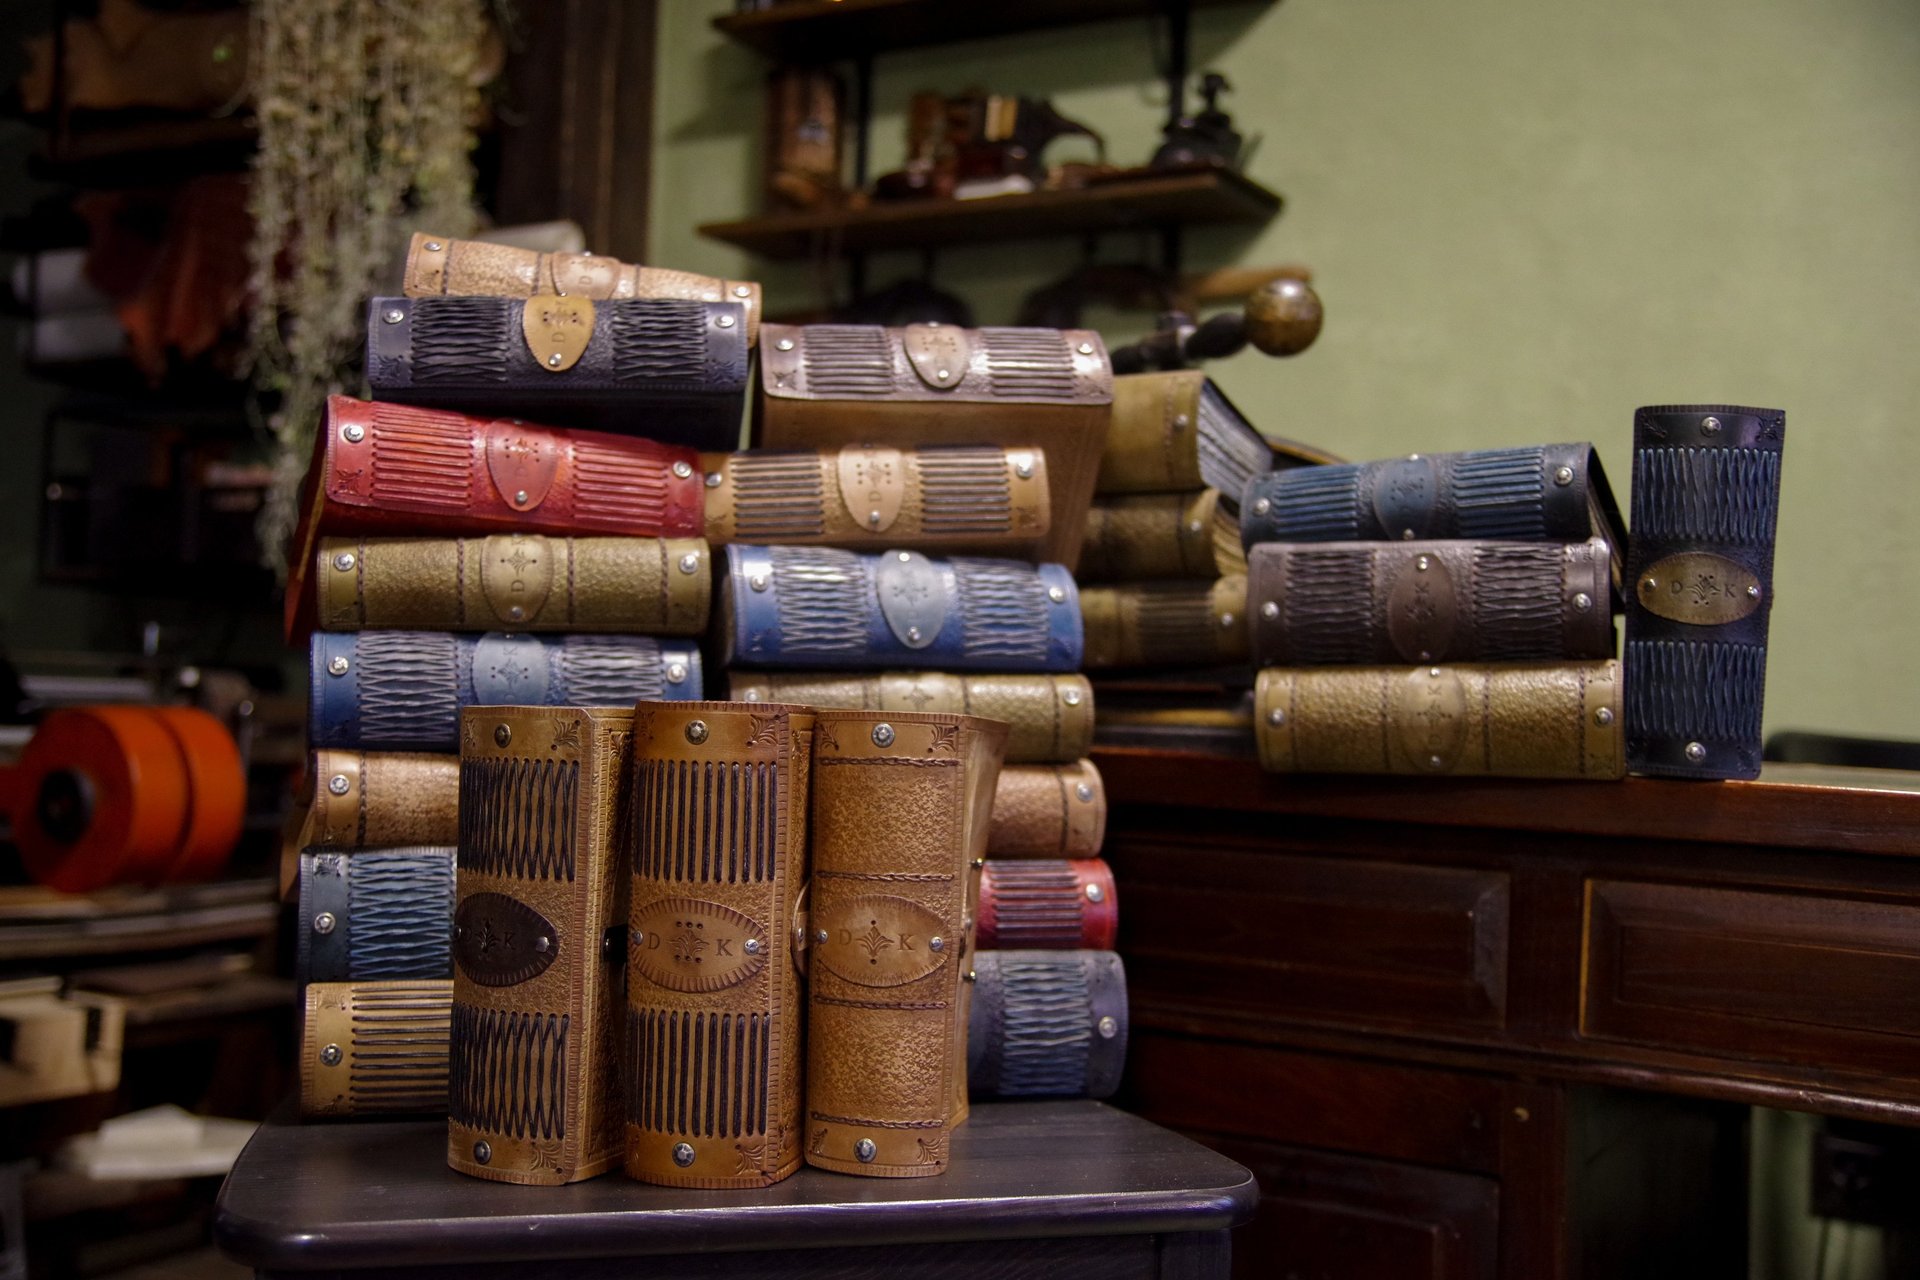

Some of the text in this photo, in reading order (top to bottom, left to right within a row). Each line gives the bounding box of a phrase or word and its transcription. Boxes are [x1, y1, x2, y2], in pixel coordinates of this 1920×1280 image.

[551, 331, 566, 343] D
[510, 580, 525, 592] D
[1671, 580, 1736, 598] D K
[504, 931, 517, 950] K
[647, 931, 733, 957] D K
[838, 928, 915, 951] D K
